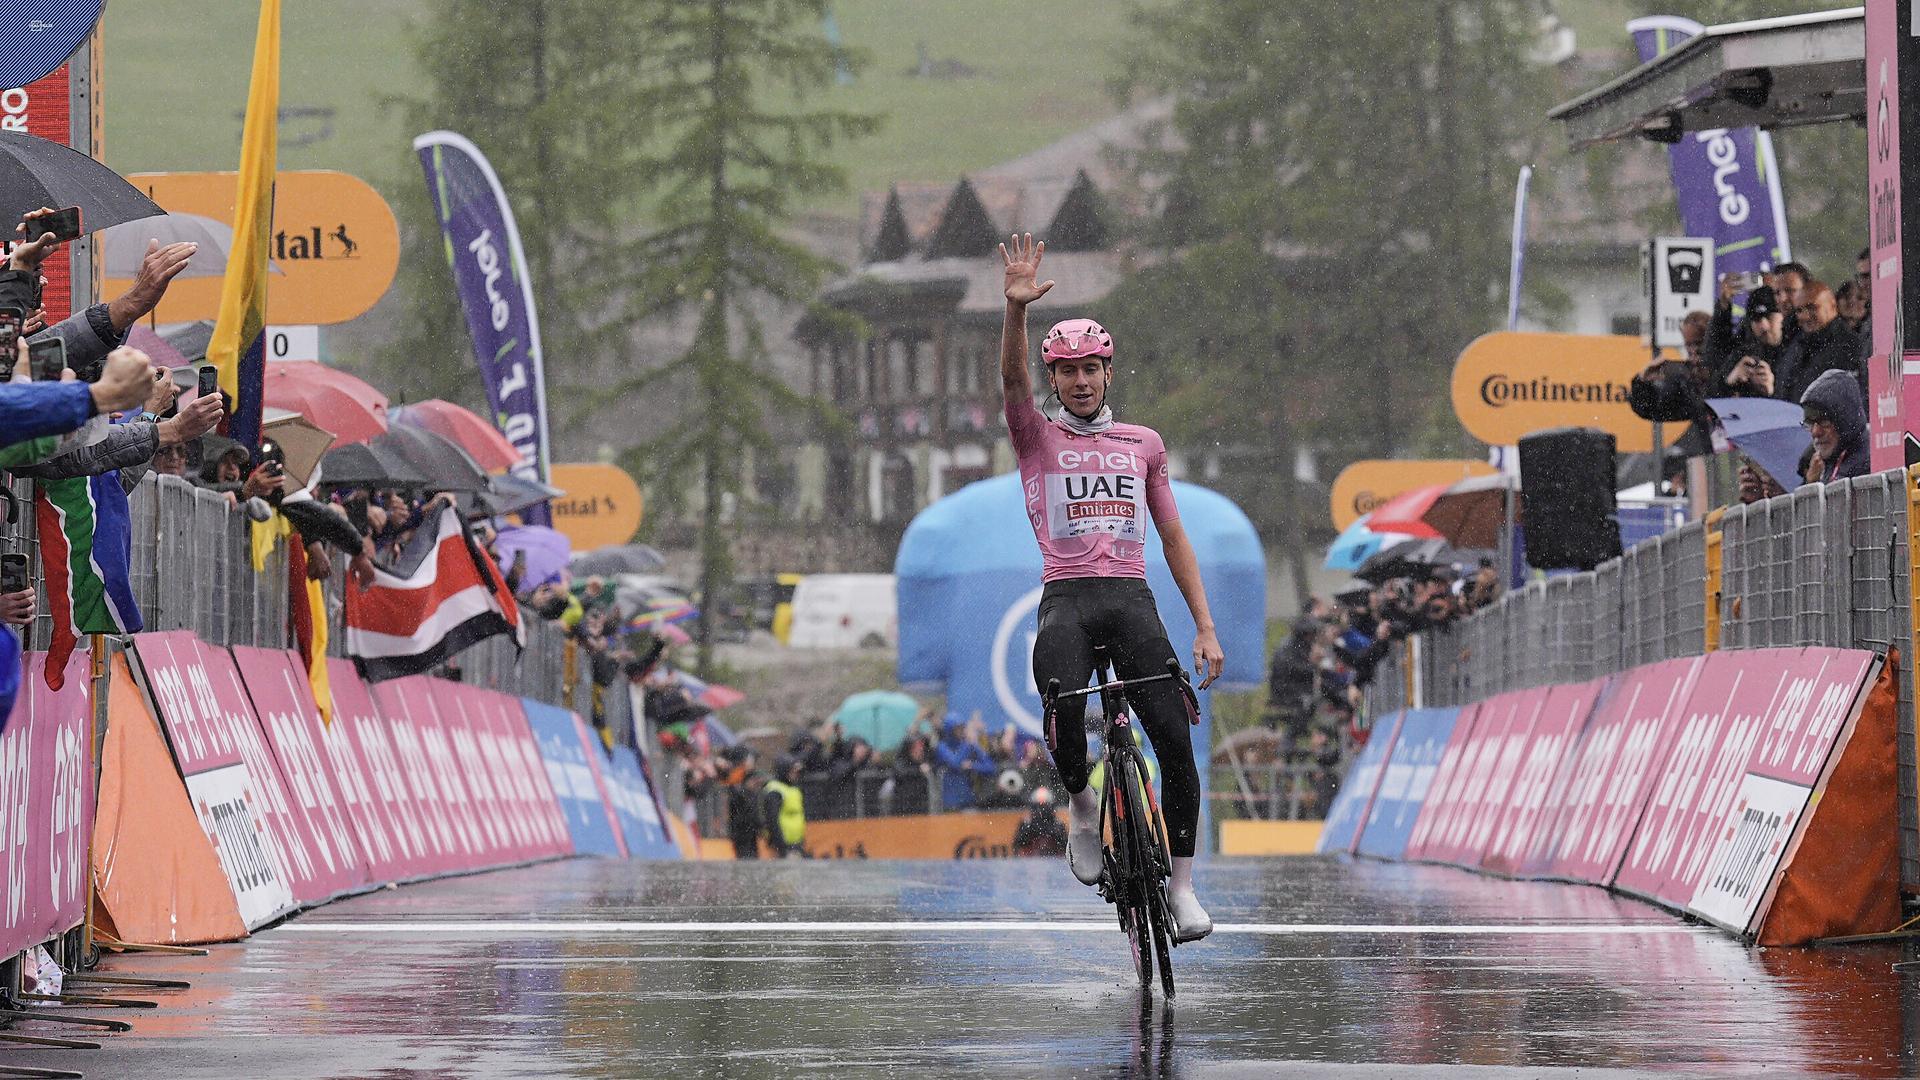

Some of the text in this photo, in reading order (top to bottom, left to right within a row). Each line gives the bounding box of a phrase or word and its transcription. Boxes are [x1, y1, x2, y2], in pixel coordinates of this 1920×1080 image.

[1696, 128, 1750, 225] enel
[469, 229, 509, 331] enel
[1480, 373, 1632, 408] Continenta
[1026, 473, 1042, 530] enel
[1058, 448, 1139, 472] enel
[1065, 475, 1135, 500] UAE
[1069, 502, 1134, 517] Emirates
[154, 640, 207, 763] enel
[187, 639, 234, 756] enel
[1759, 656, 1829, 768] enel
[1792, 659, 1866, 775] enel
[51, 669, 87, 912] enel
[226, 669, 317, 884] enel
[269, 669, 358, 874] enel
[1632, 669, 1743, 875] enel
[1672, 669, 1787, 886] enel
[211, 797, 275, 892] TUDOR
[1714, 808, 1781, 899] TUDOR
